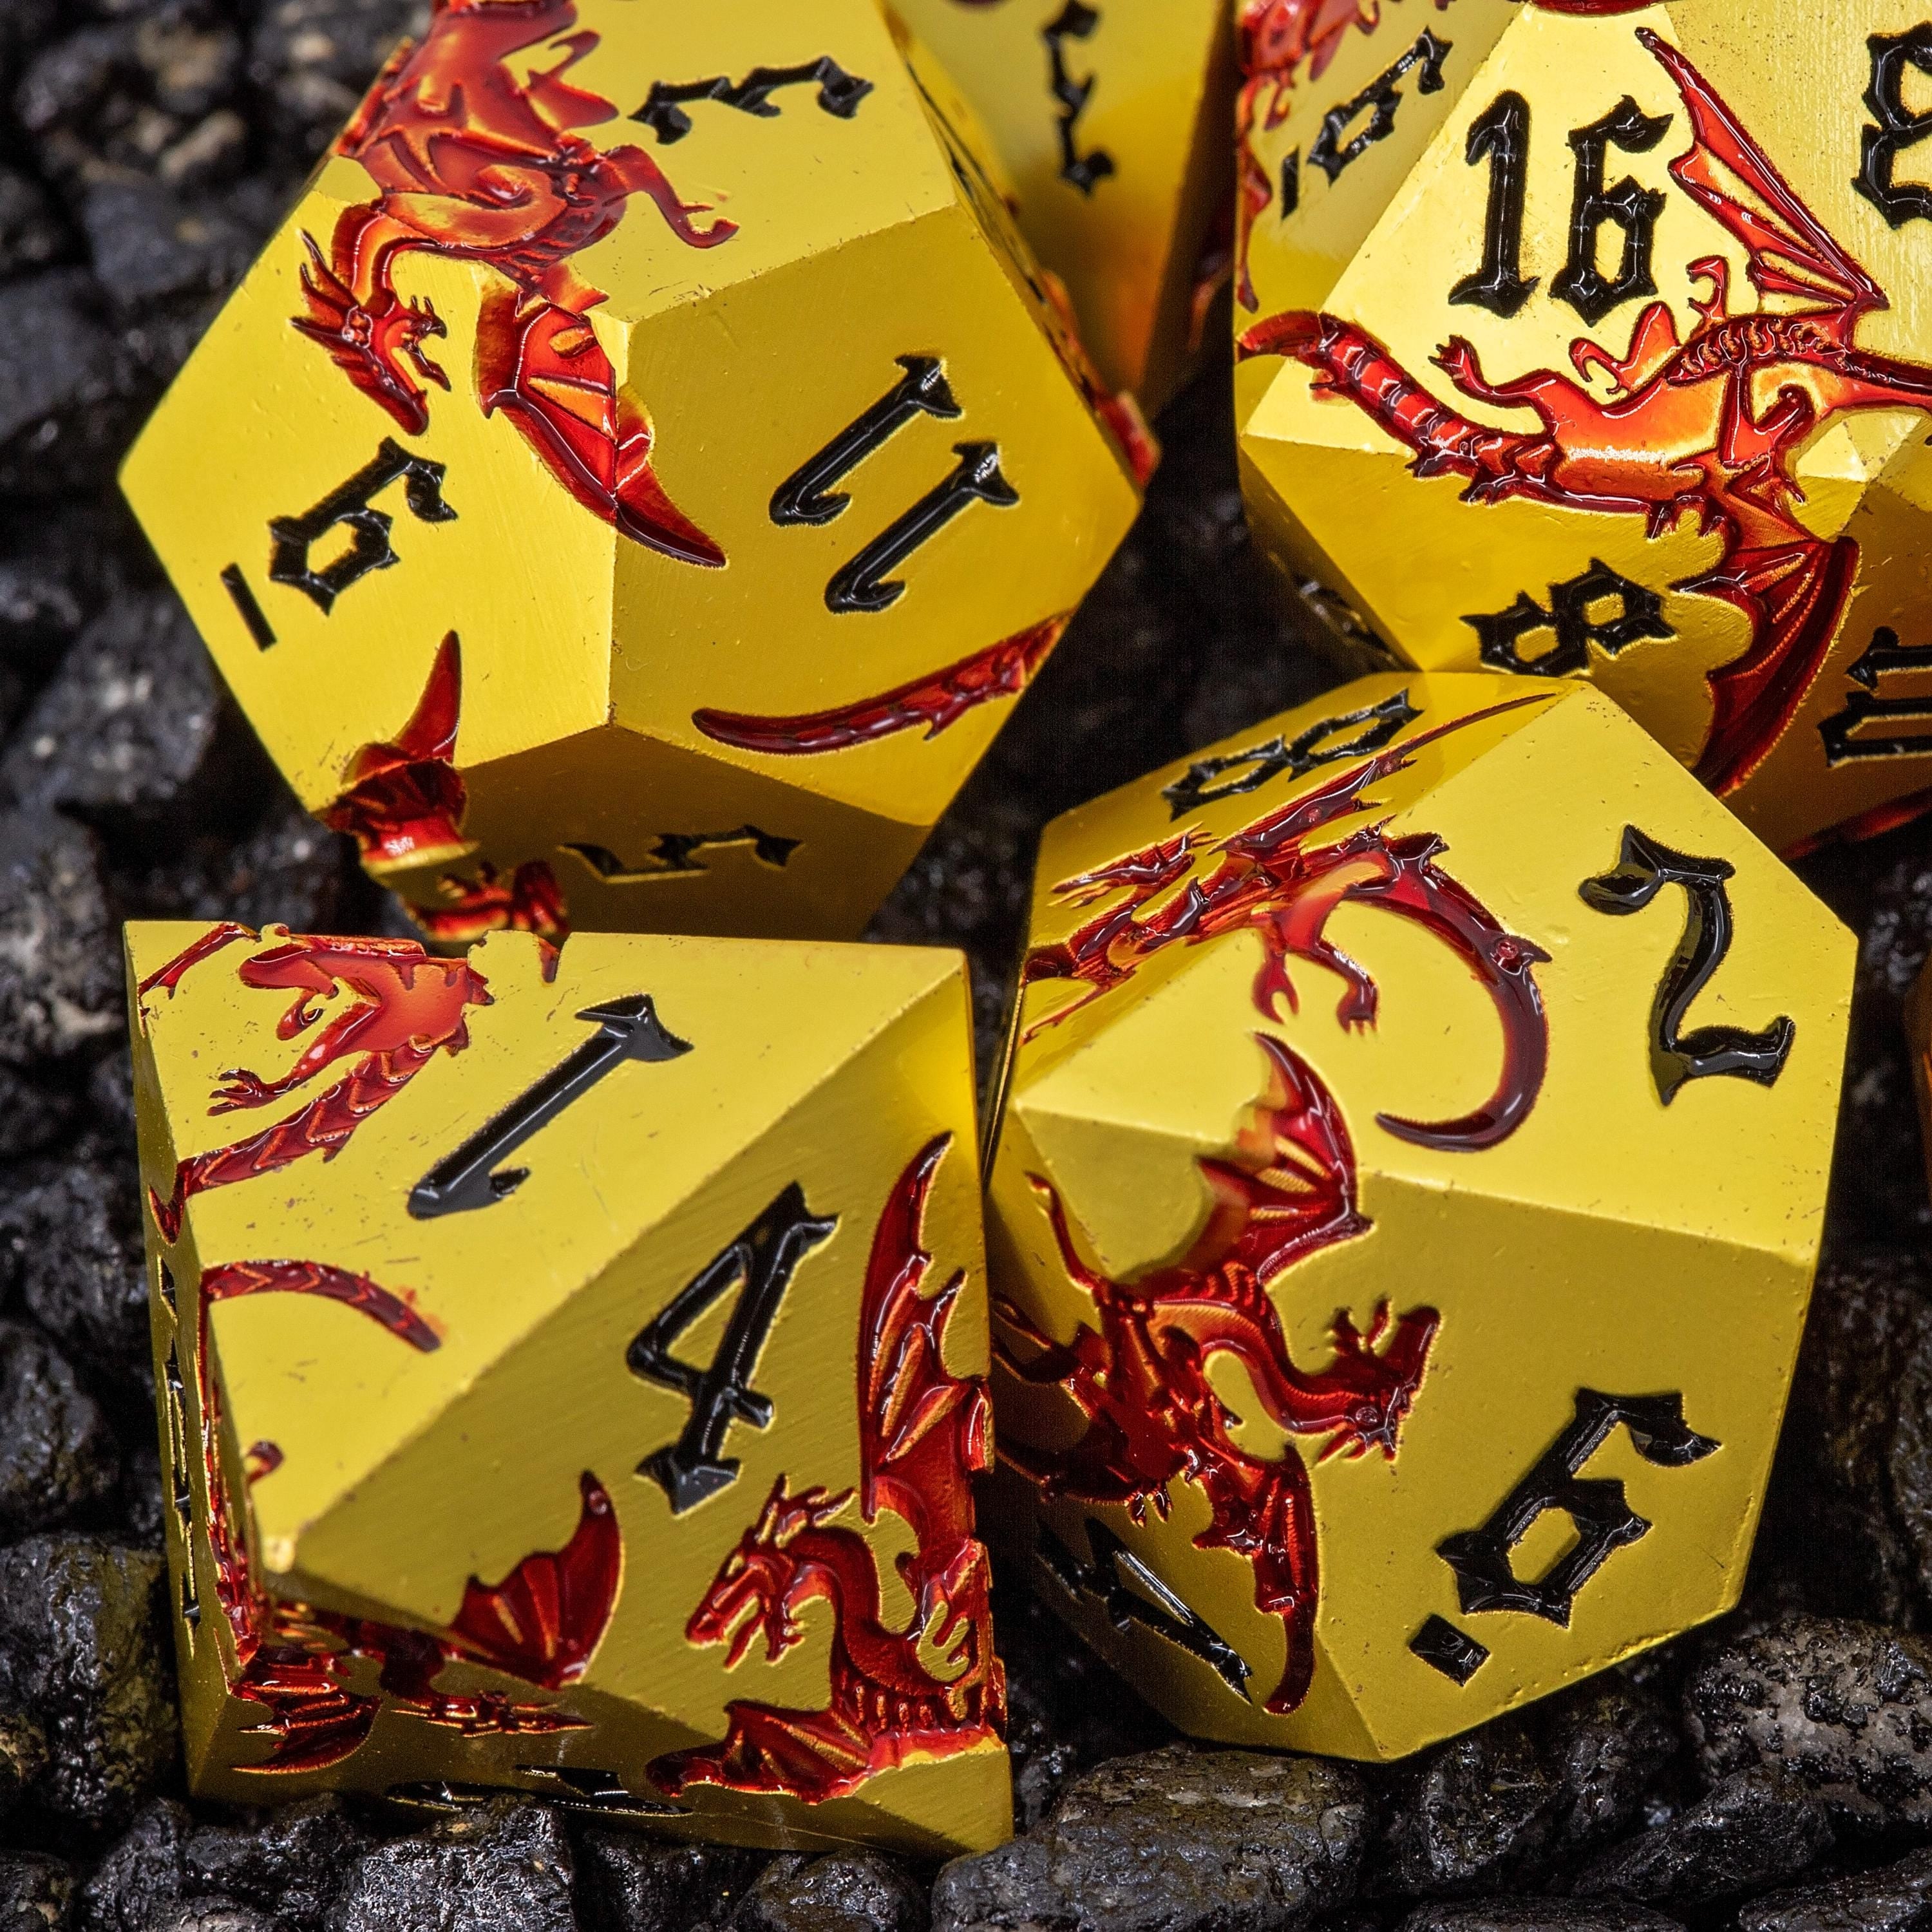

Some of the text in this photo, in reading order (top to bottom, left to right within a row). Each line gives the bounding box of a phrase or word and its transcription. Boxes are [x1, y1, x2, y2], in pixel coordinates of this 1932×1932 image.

[627, 55, 874, 145] 3
[1448, 89, 1674, 327] 16
[769, 354, 1021, 615] 11
[1461, 558, 1676, 677] 8
[1161, 688, 1424, 822] 8
[1578, 824, 1796, 1106] 2
[408, 994, 694, 1220] 1
[626, 1181, 840, 1513] 4
